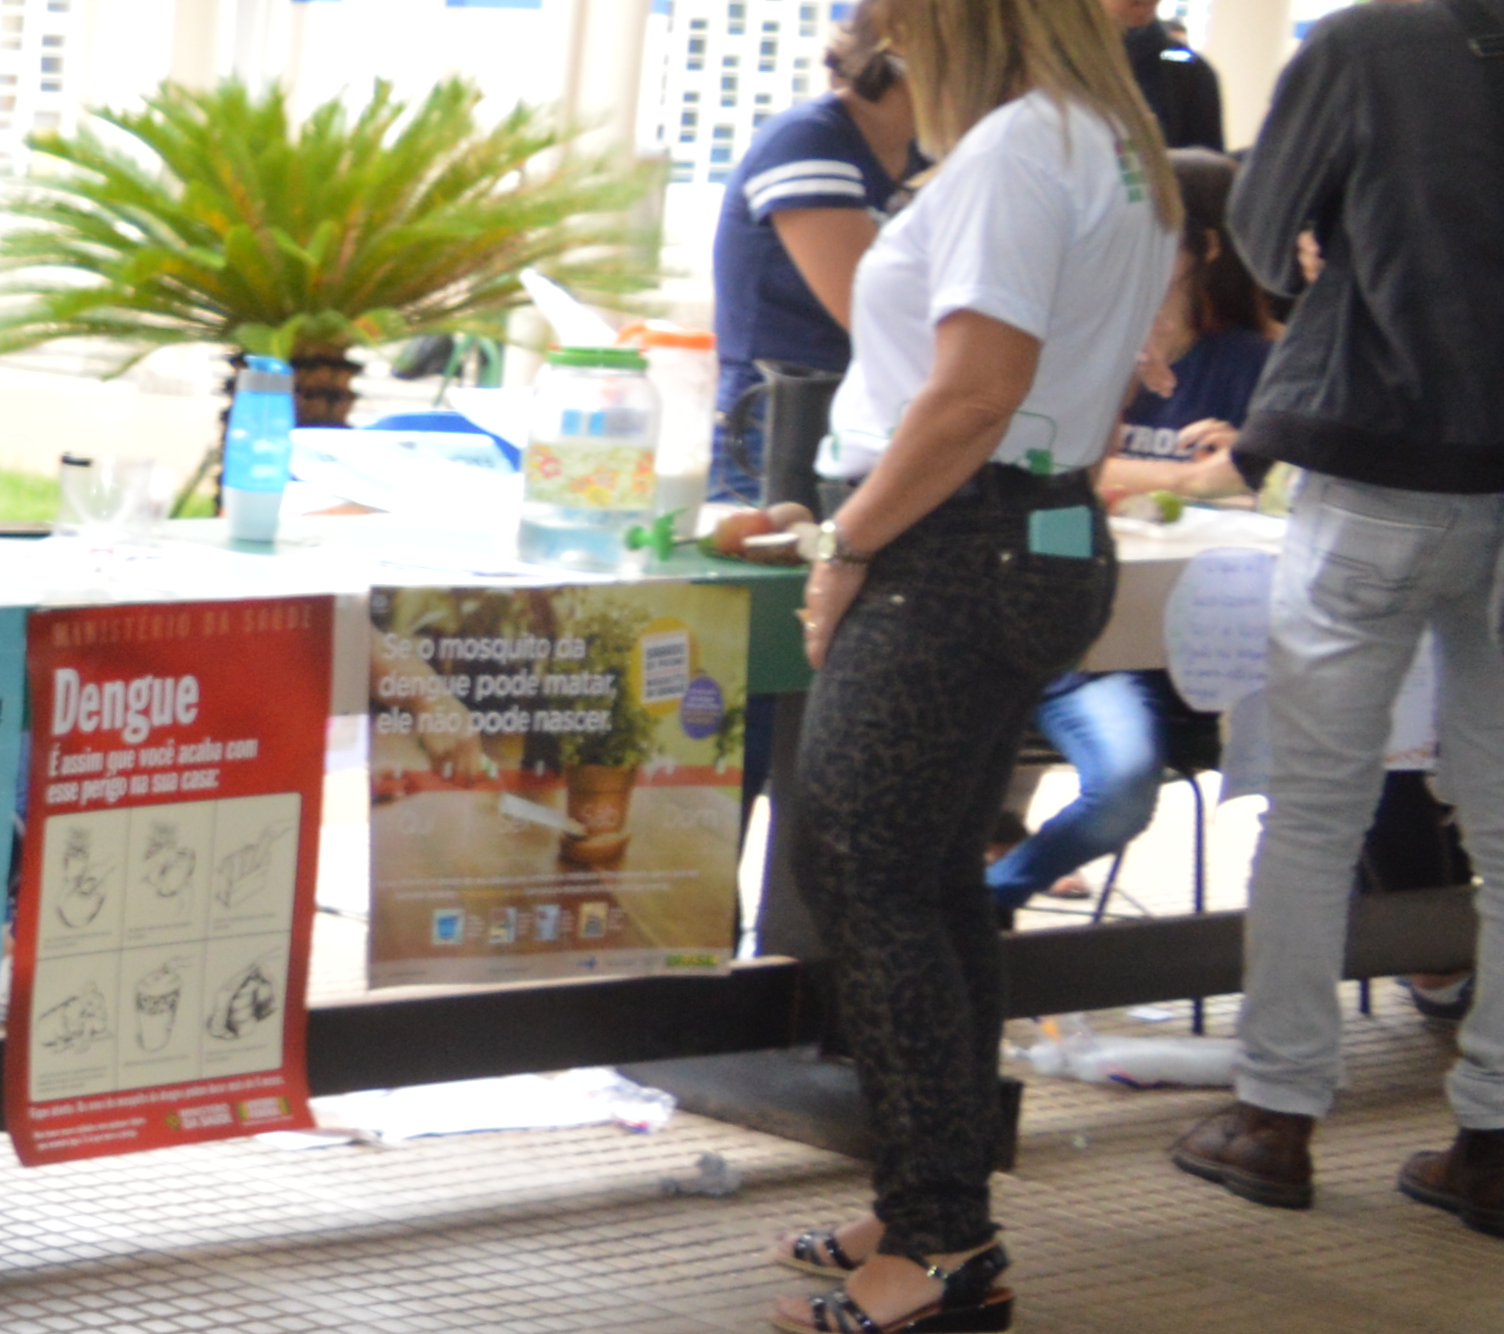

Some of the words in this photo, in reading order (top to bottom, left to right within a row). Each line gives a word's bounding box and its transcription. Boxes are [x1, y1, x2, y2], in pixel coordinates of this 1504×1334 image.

[382, 633, 410, 661] Se
[418, 640, 435, 661] o
[439, 634, 552, 667] mosquito
[555, 633, 586, 660] da
[52, 667, 200, 744] Dengue
[378, 671, 471, 706] dengue
[475, 669, 540, 705] pode
[544, 671, 618, 699] matar,
[377, 709, 413, 734] ele
[419, 708, 462, 734] não
[468, 707, 530, 741] pode
[534, 708, 613, 733] nascer.
[48, 743, 62, 778] É
[61, 747, 104, 775] assim
[107, 748, 135, 777] que
[139, 739, 176, 767] você
[178, 737, 222, 764] acaba
[225, 739, 259, 760] com
[45, 782, 79, 805] esse
[80, 775, 128, 807] perigo
[129, 774, 150, 795] na
[152, 771, 179, 794] sua
